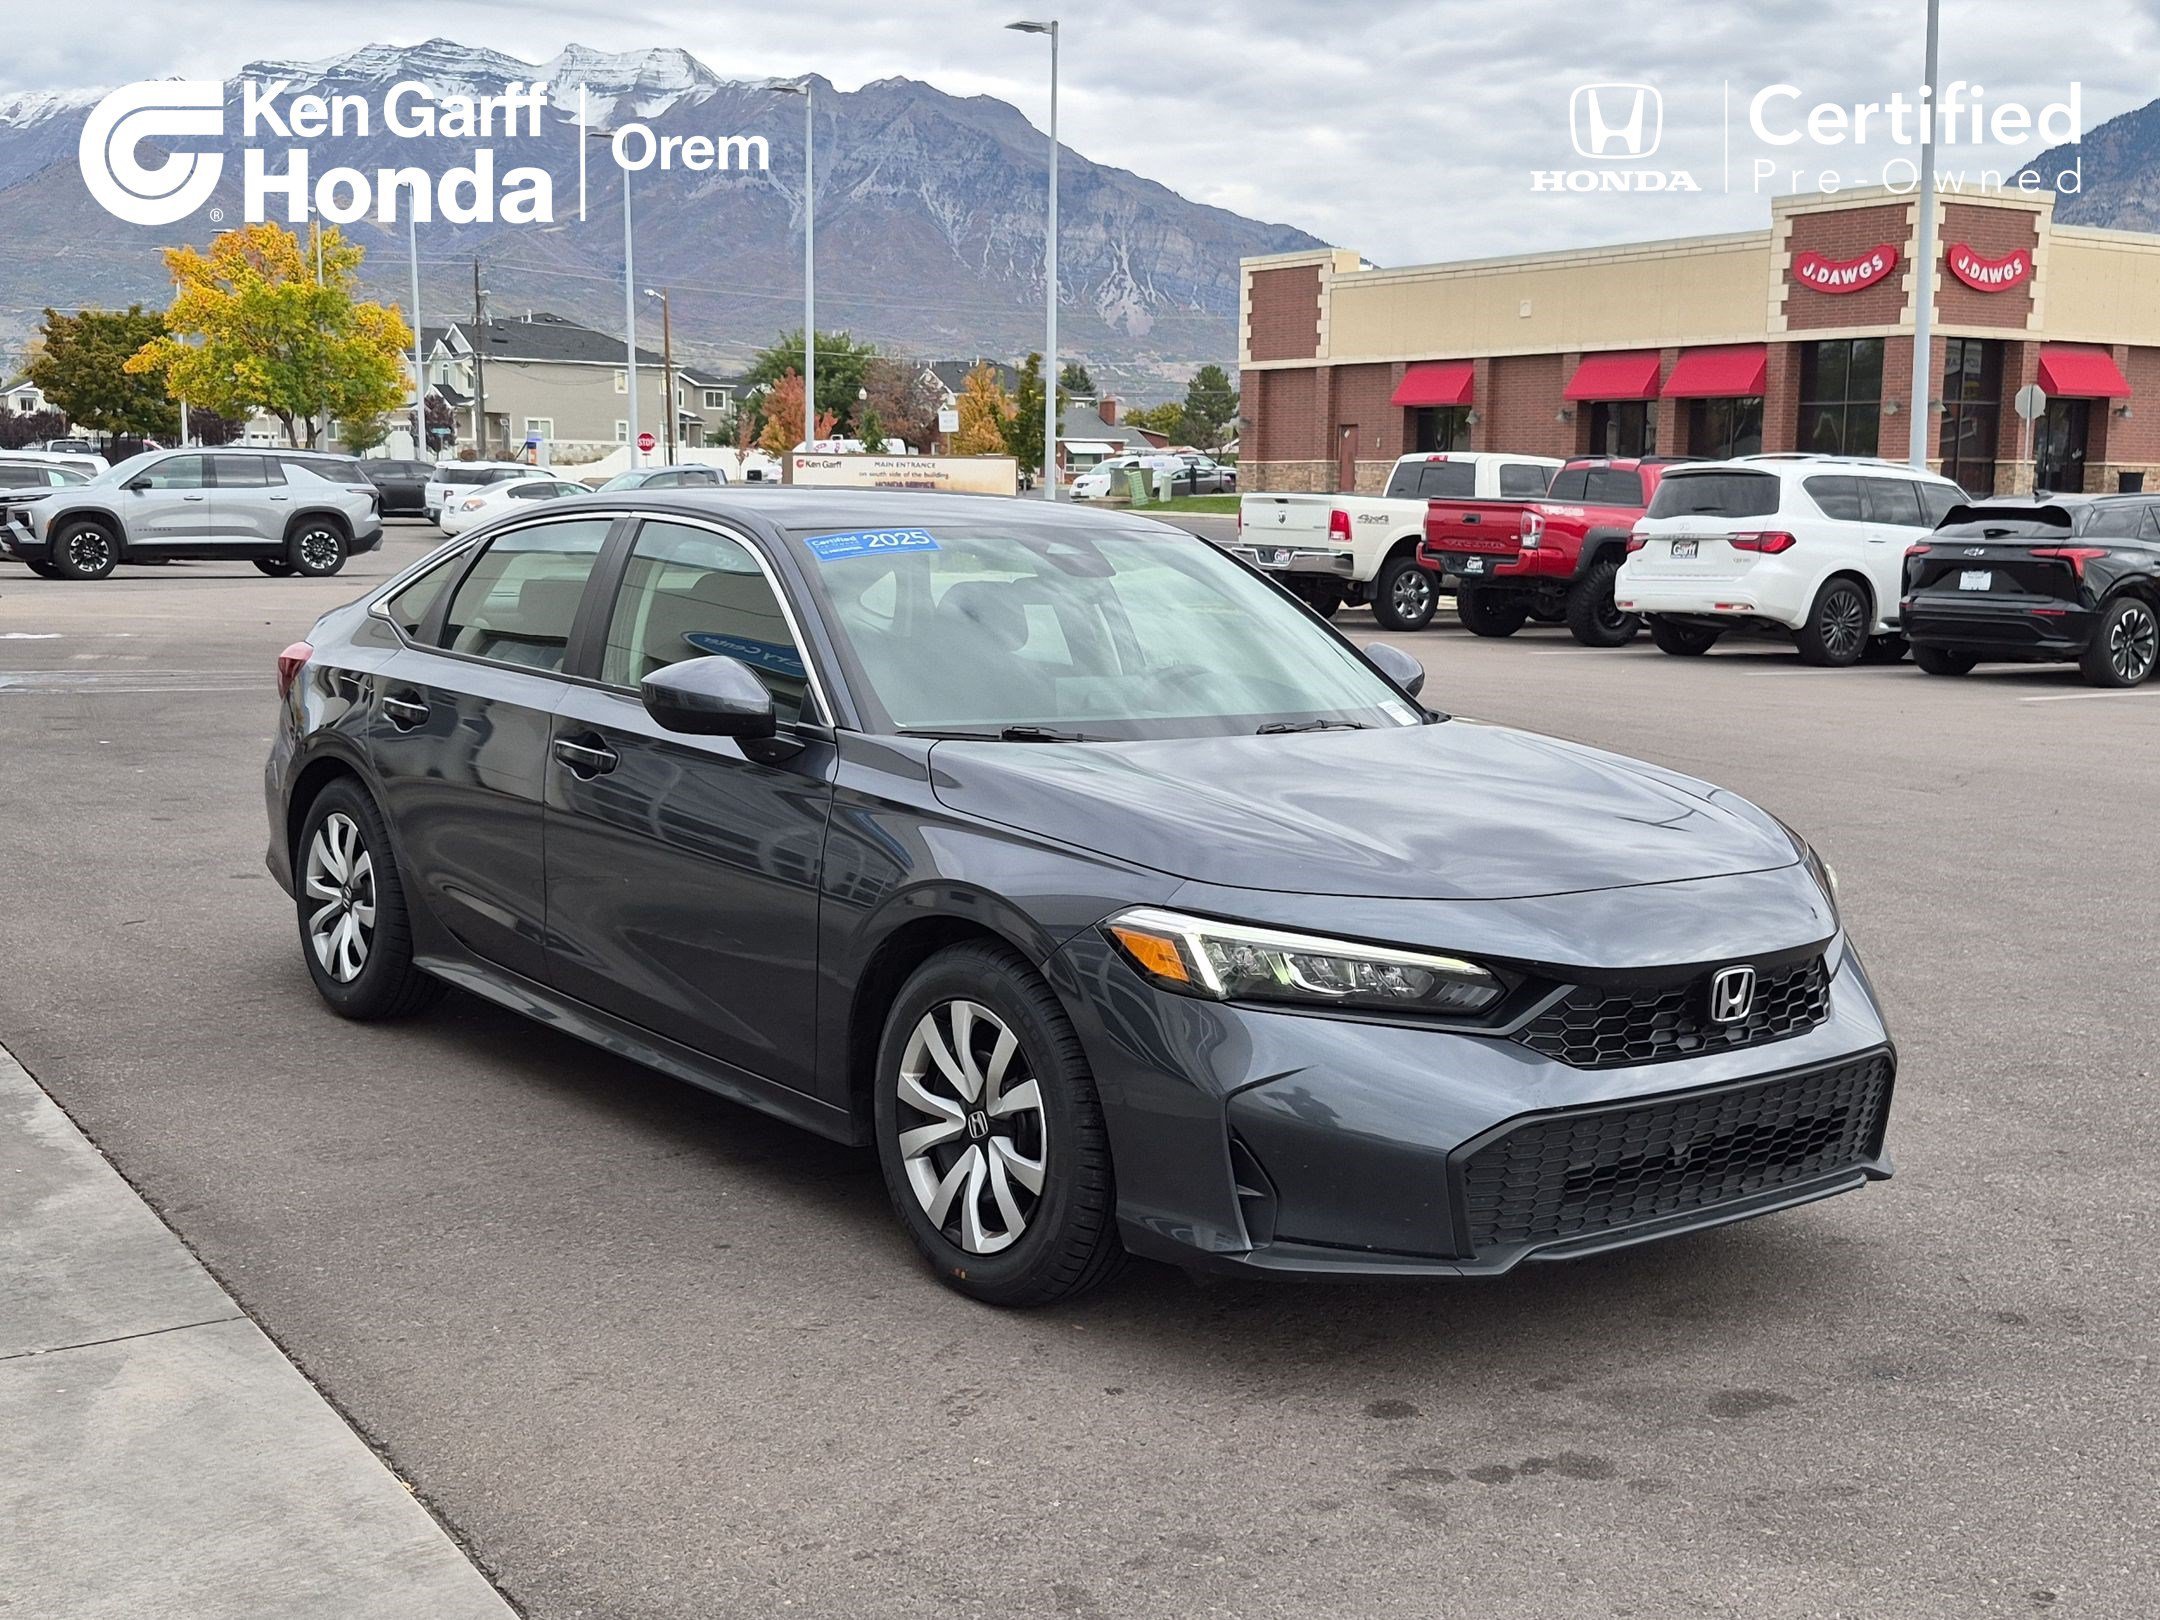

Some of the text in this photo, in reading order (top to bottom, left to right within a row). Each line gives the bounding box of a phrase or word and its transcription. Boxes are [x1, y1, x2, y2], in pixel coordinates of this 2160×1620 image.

[1802, 254, 1883, 285] J.DAWGS
[1958, 255, 2023, 284] J.DAWGS
[638, 438, 655, 446] STOP
[806, 460, 842, 468] Ken Garff
[924, 472, 949, 480] building
[1357, 514, 1390, 524] 4x4
[862, 531, 930, 548] 2025
